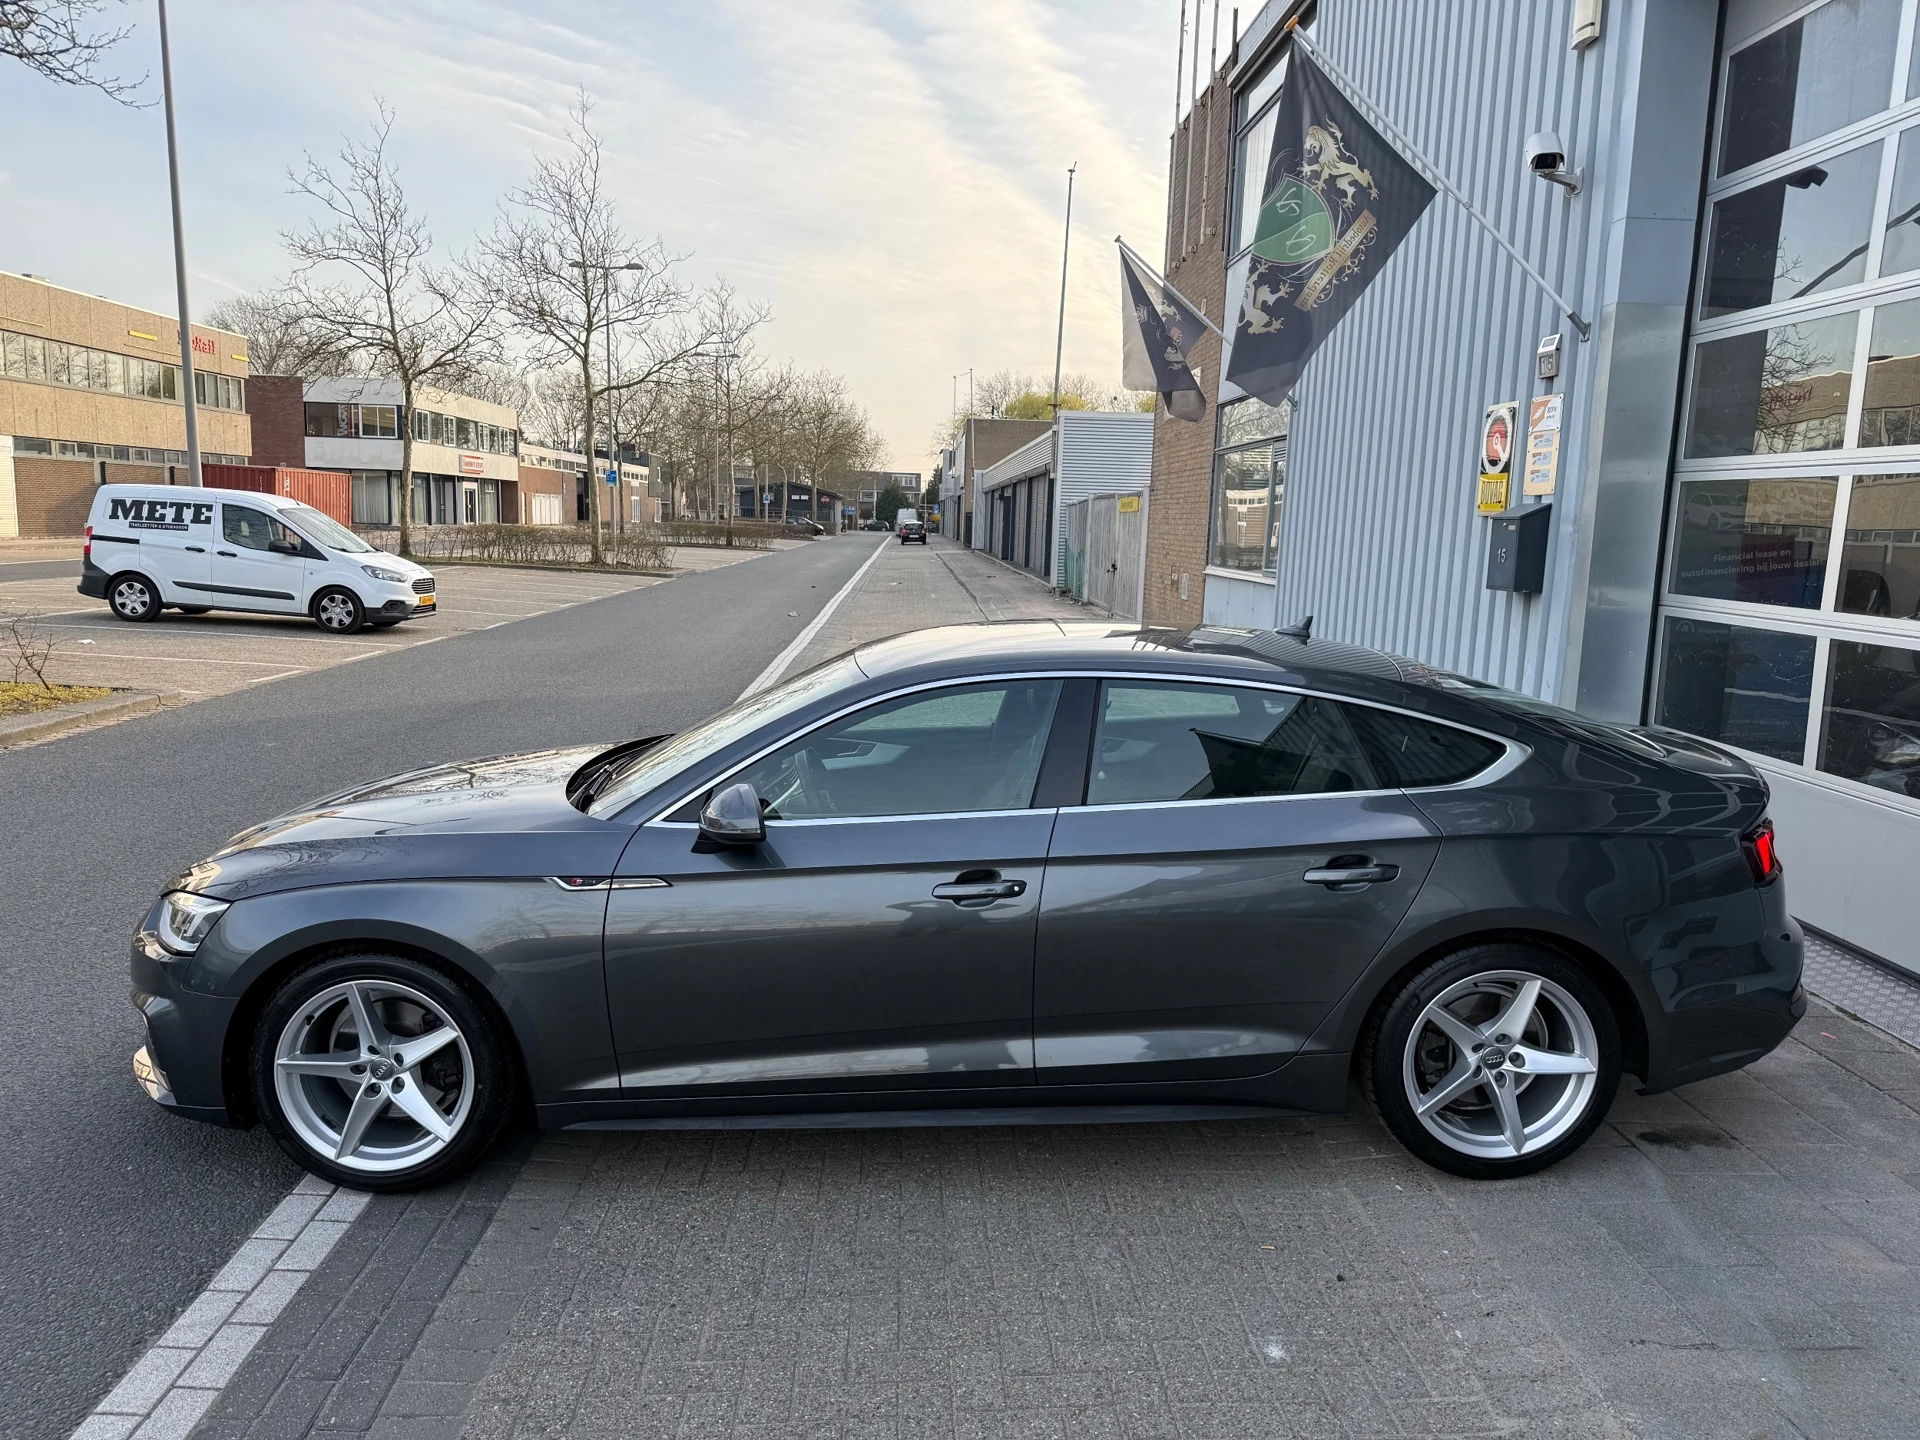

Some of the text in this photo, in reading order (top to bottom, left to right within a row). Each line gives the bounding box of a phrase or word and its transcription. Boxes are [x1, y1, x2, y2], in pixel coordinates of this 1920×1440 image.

[1542, 356, 1553, 373] 15
[1480, 481, 1503, 504] BOVAG
[109, 499, 213, 524] METE
[1497, 548, 1506, 563] 15
[1713, 549, 1791, 562] Financial lease en
[1681, 558, 1824, 578] autofinanciering bij jouw dealer!
